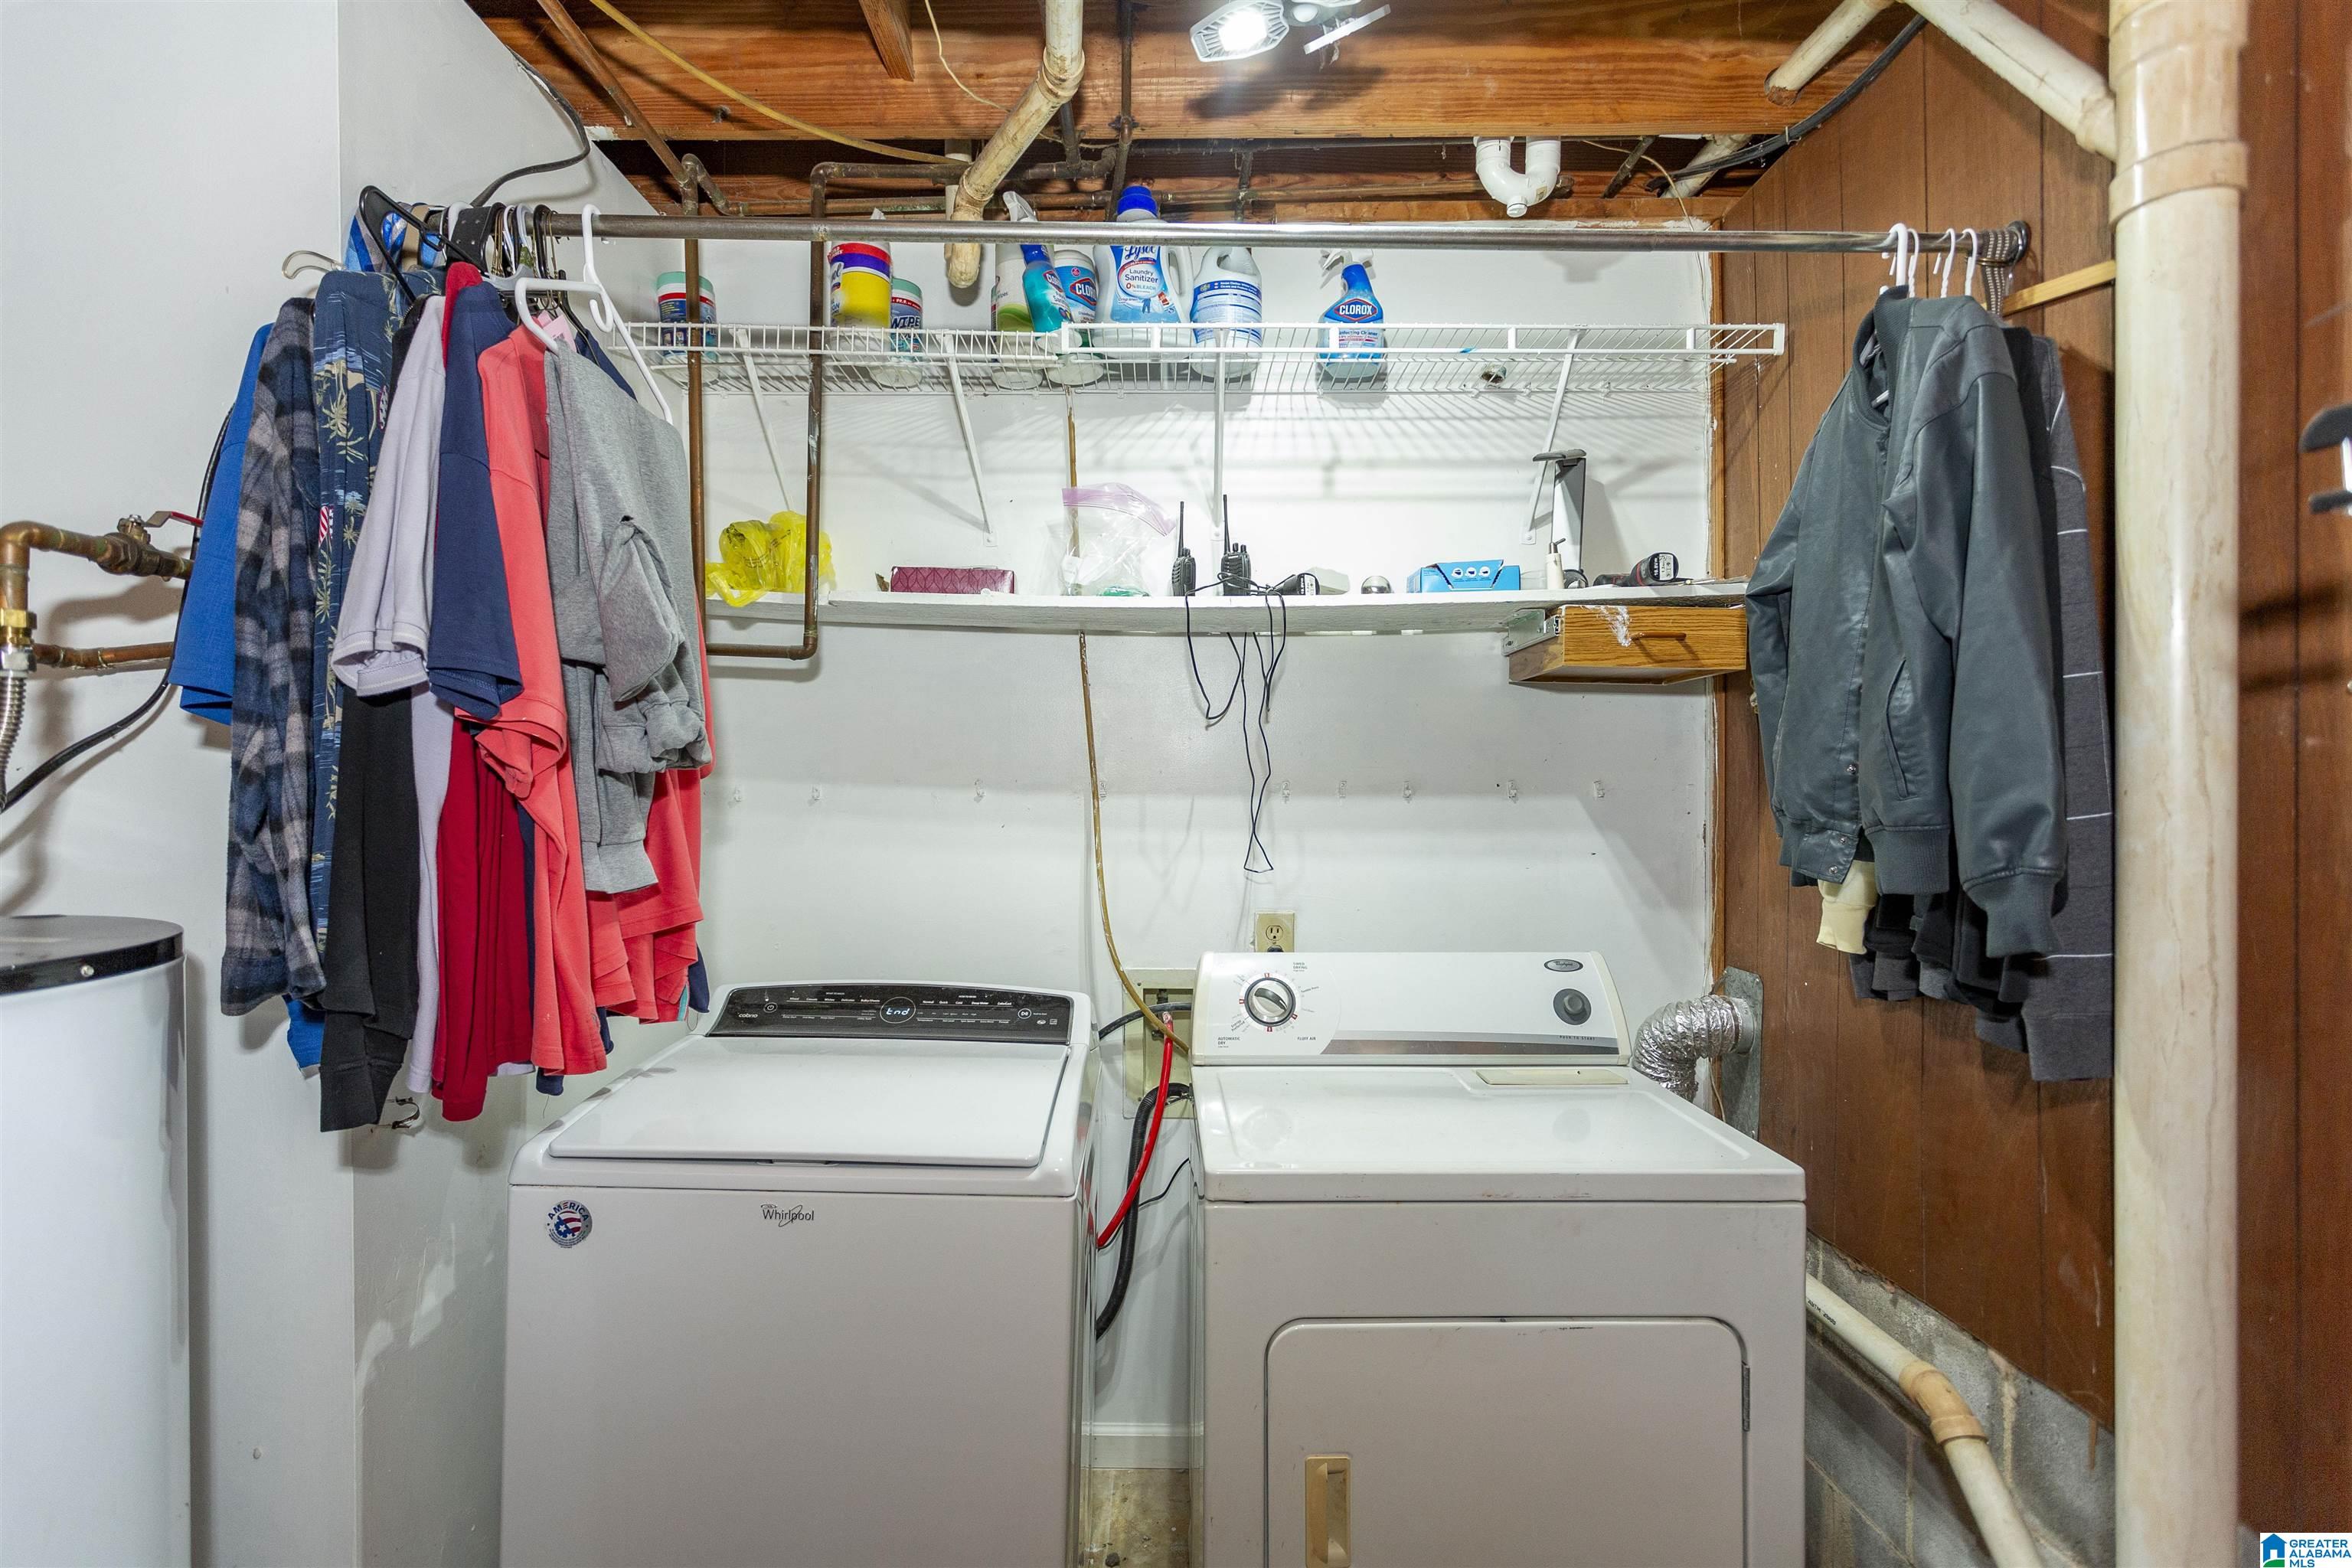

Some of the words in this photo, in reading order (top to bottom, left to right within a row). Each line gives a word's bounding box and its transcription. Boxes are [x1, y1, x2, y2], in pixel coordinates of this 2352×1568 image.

[1125, 274, 1158, 283] Sanitizer
[1339, 305, 1373, 315] CLOROX
[548, 1201, 589, 1220] AMERICA
[762, 1205, 814, 1227] Whirlpool
